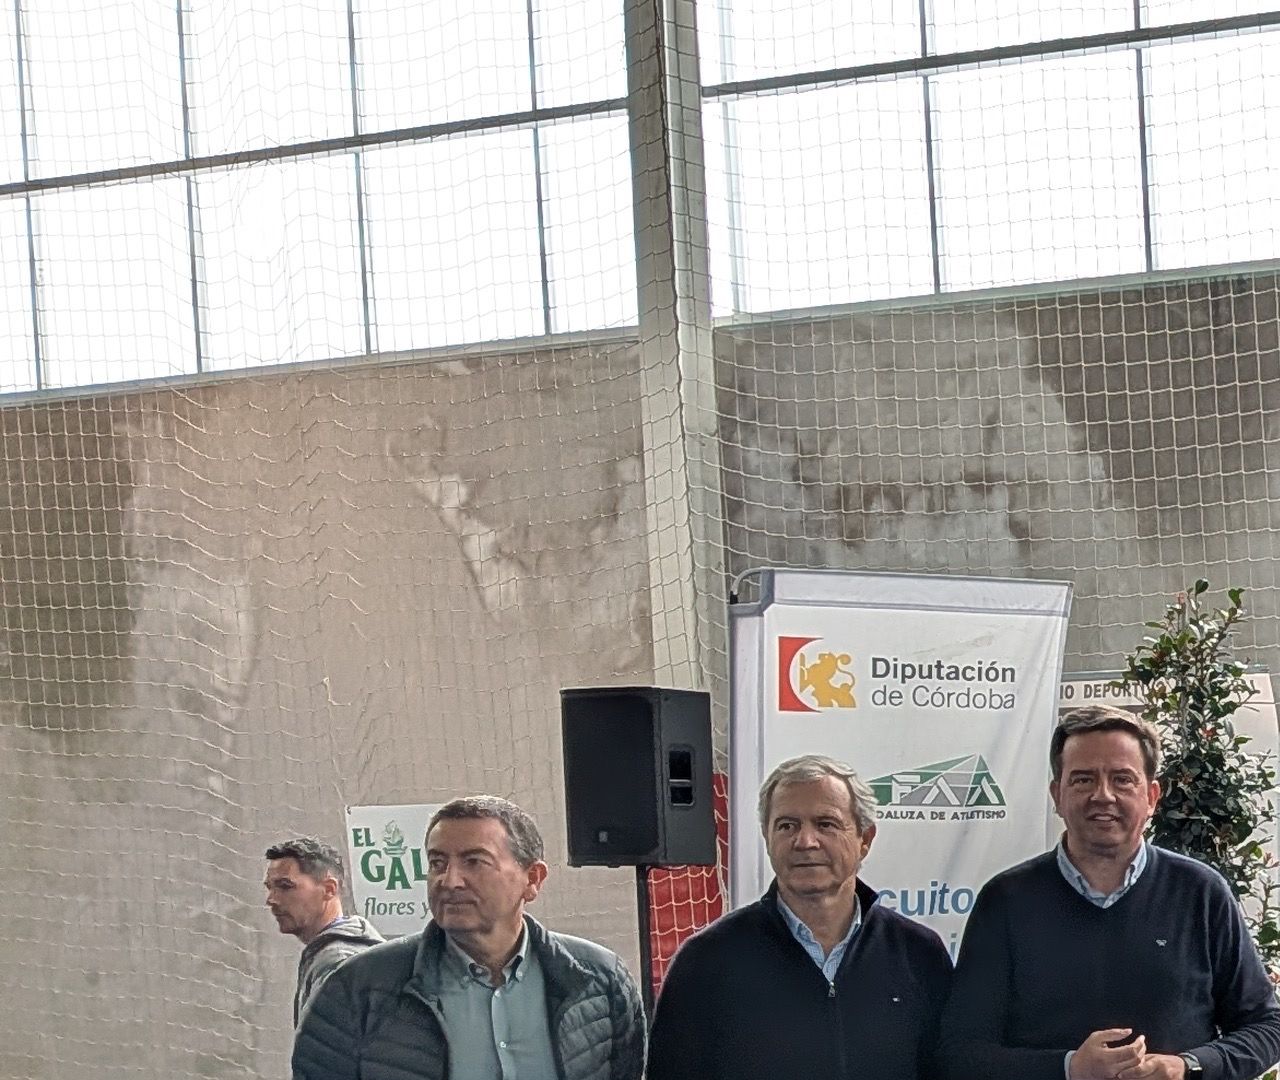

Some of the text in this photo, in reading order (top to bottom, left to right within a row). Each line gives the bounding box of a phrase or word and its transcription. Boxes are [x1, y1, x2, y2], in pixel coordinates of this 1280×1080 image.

[871, 656, 1016, 684] Diputación
[871, 685, 1016, 710] de Córdoba
[876, 809, 1006, 821] DALUZA DE ATLETISMO
[352, 827, 376, 847] EL
[361, 848, 428, 890] GAL
[364, 897, 415, 919] flores
[878, 881, 974, 916] cuito
